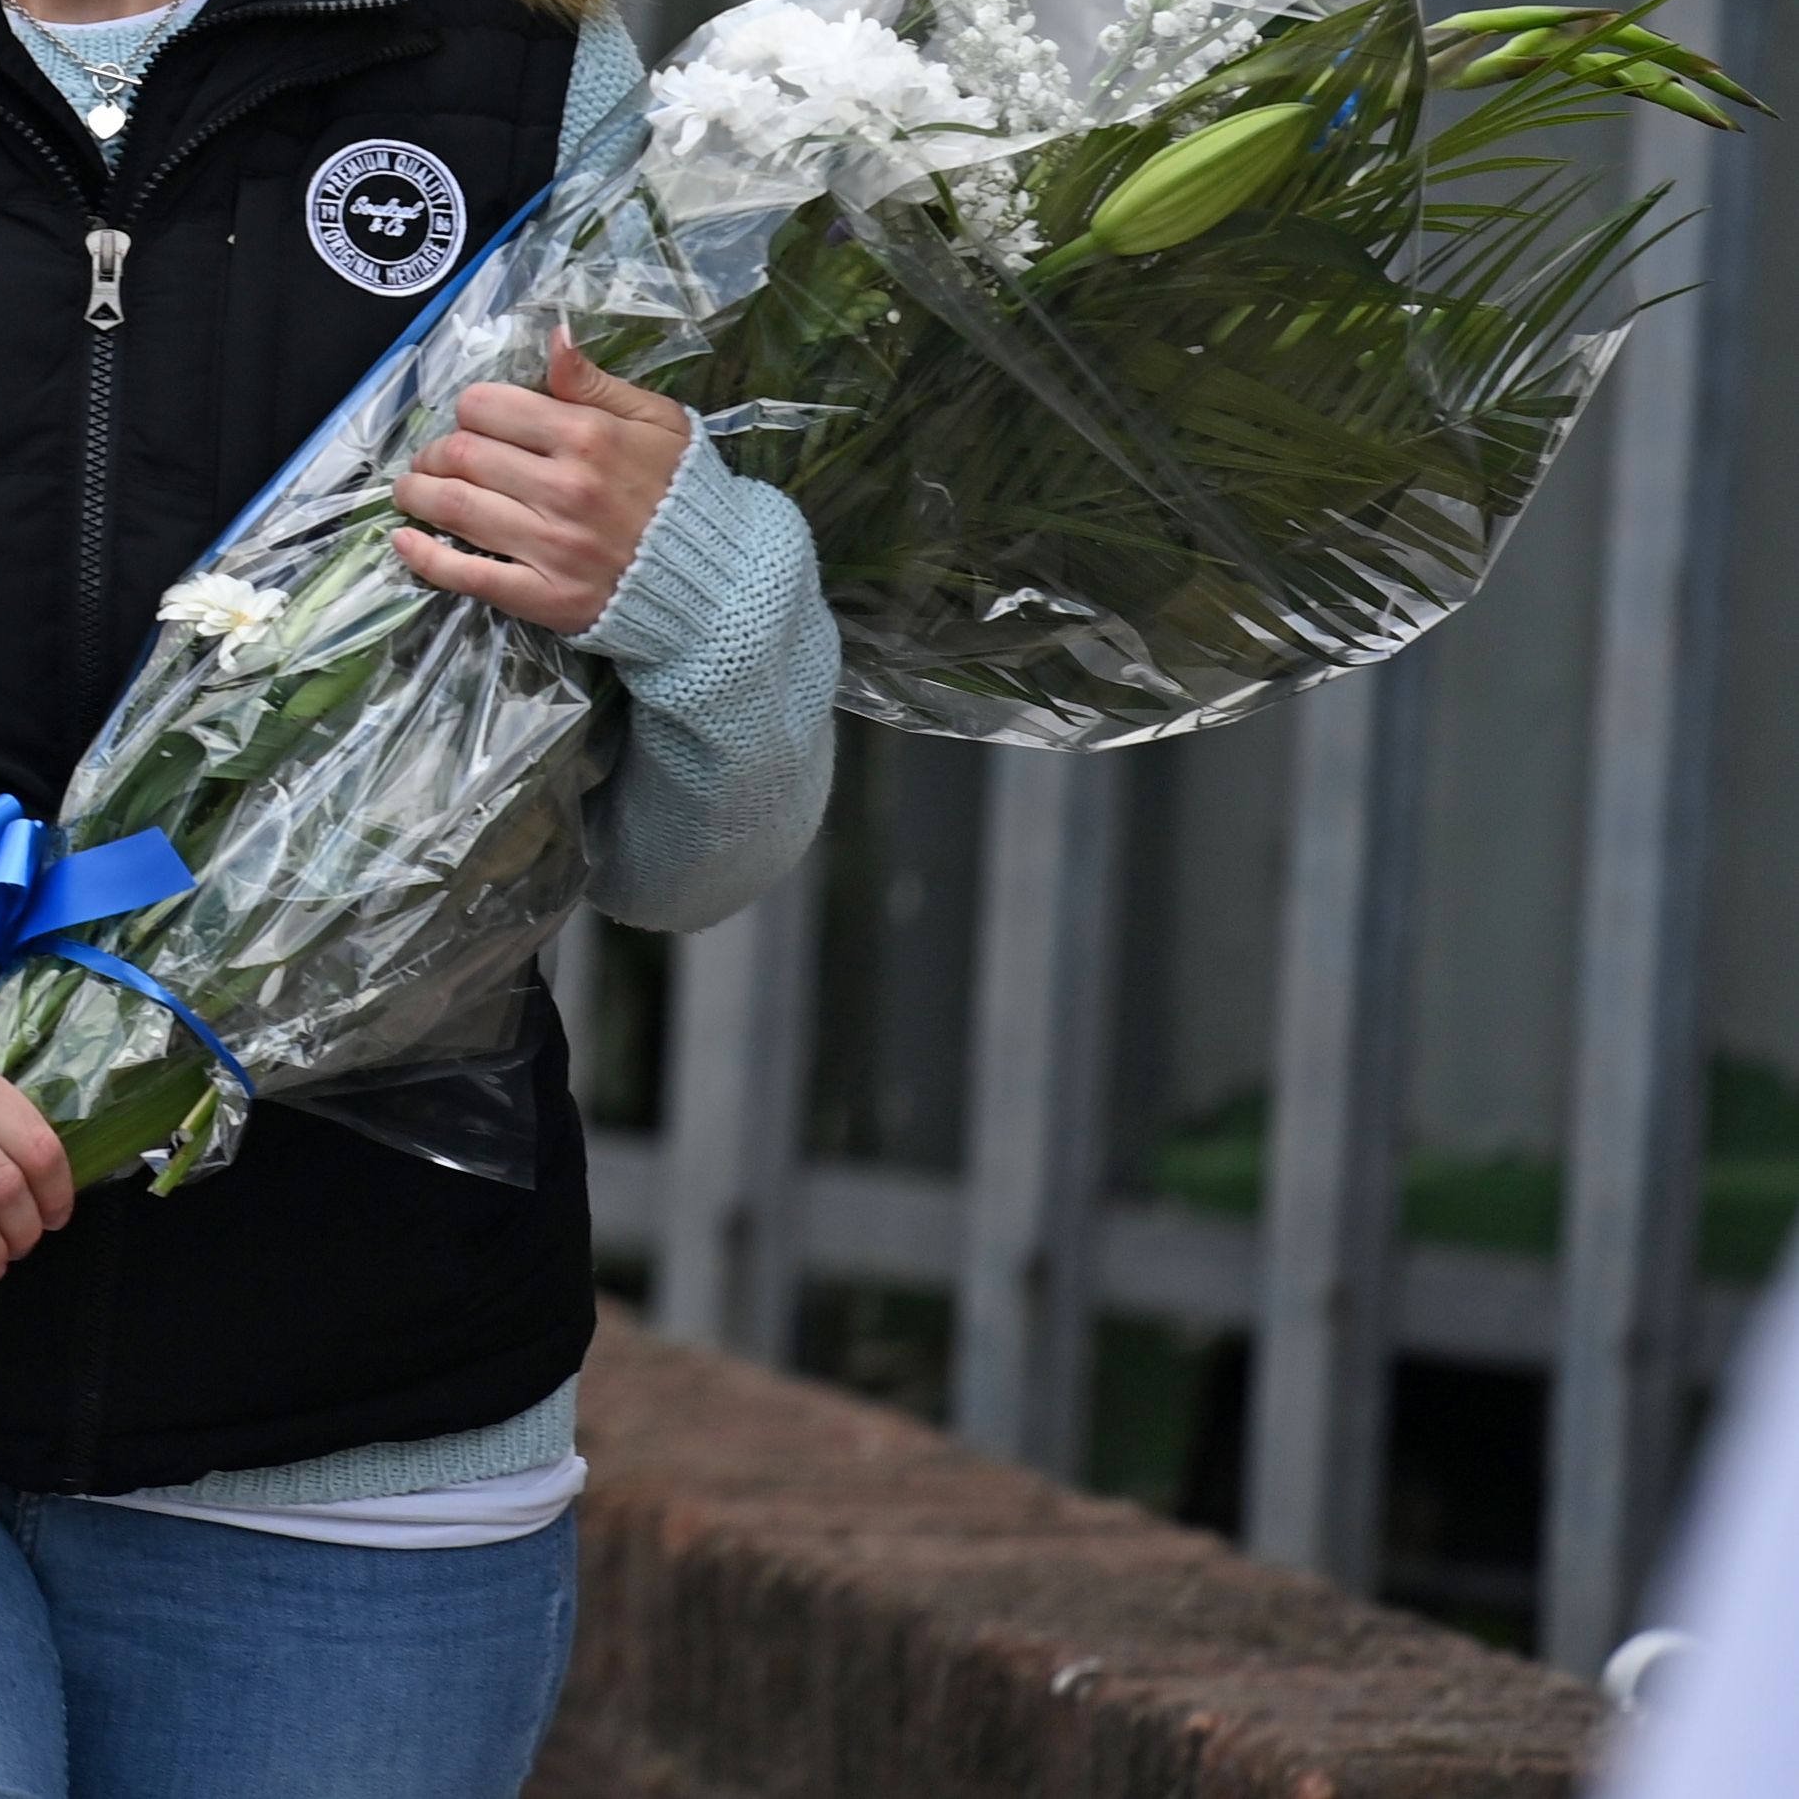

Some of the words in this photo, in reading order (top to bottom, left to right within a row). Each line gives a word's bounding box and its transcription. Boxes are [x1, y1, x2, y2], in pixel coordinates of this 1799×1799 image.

[323, 150, 391, 196] PREMIUM
[394, 154, 450, 208] QUALITY
[323, 229, 382, 284] ORIGINAL
[386, 243, 446, 285] HERITAGE
